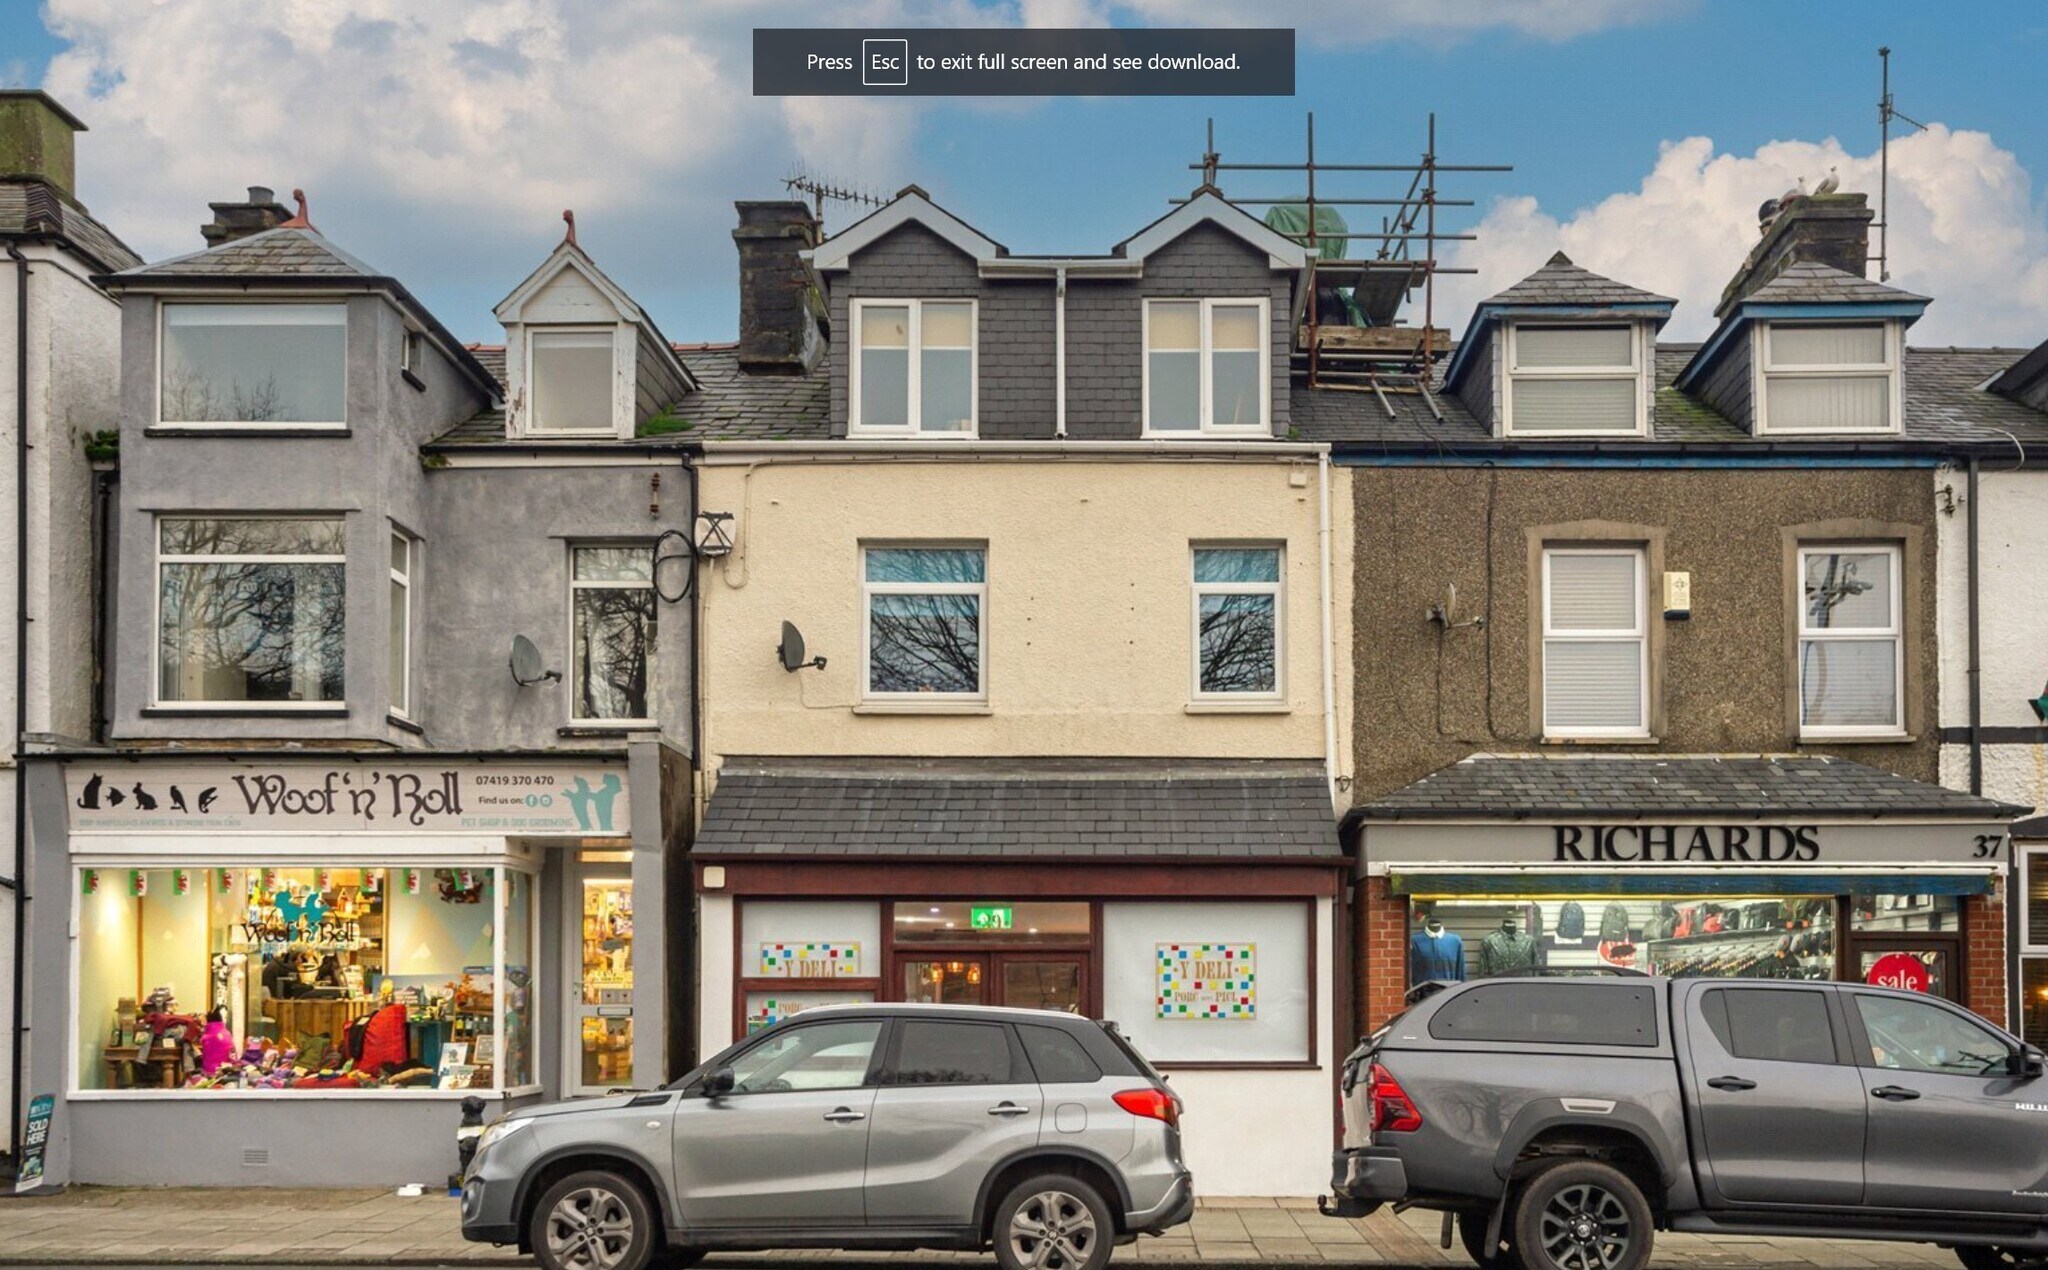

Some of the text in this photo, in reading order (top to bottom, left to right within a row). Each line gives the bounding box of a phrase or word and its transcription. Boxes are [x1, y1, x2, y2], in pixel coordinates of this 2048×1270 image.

[476, 775, 554, 786] 07419 370 470
[231, 772, 339, 815] Woof
[386, 771, 463, 825] Roll
[478, 796, 497, 805] Find
[461, 817, 476, 827] PET
[1552, 825, 1820, 862] RICHARDS
[1973, 835, 2003, 859] 37
[800, 960, 837, 978] DELI
[1180, 961, 1233, 979] Y DELI
[1877, 970, 1918, 991] sale
[28, 1118, 48, 1133] SOLD
[26, 1130, 46, 1145] HERE
